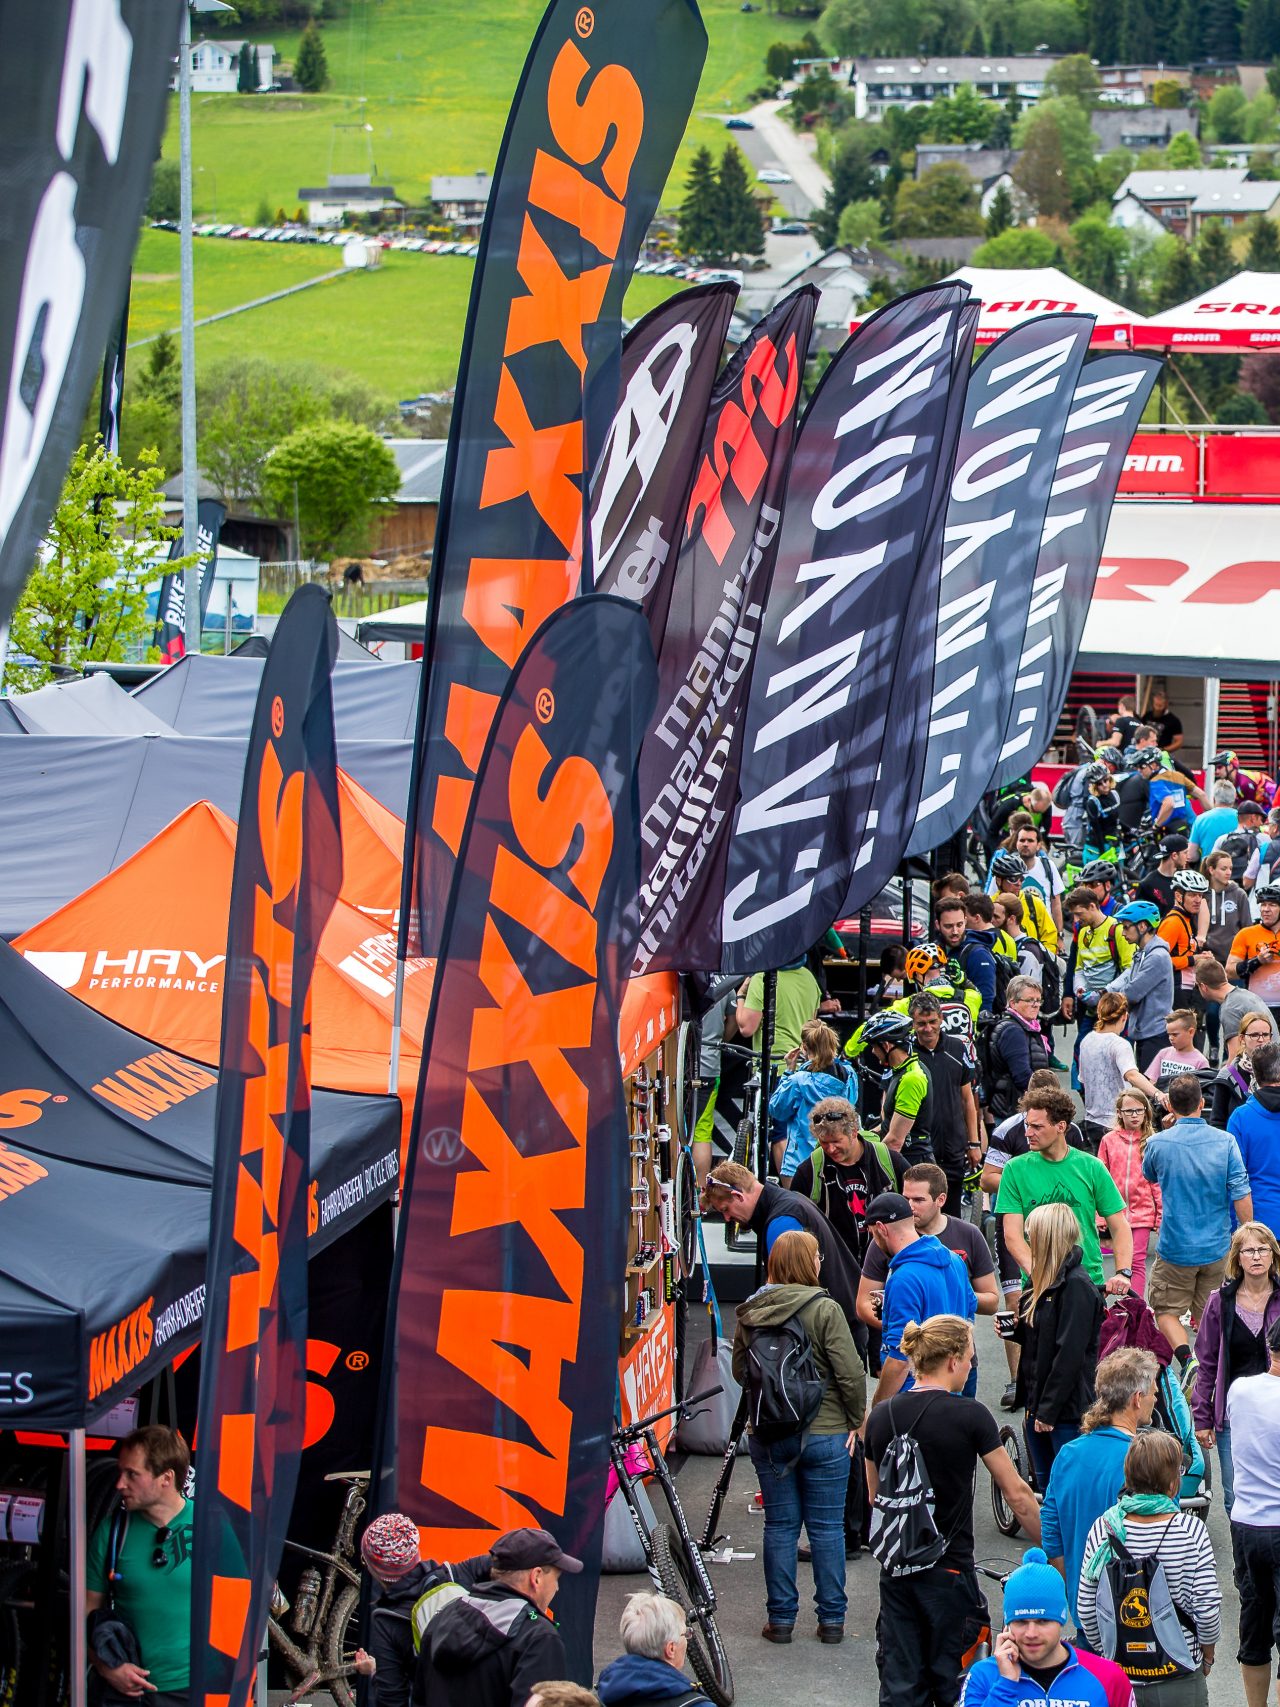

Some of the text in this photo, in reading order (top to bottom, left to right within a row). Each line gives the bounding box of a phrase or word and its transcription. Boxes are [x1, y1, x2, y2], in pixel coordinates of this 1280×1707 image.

[1171, 332, 1222, 343] SRAM
[89, 977, 219, 994] PERFORMANCE
[664, 1259, 672, 1300] manitou
[88, 1295, 156, 1401] MAXXIS
